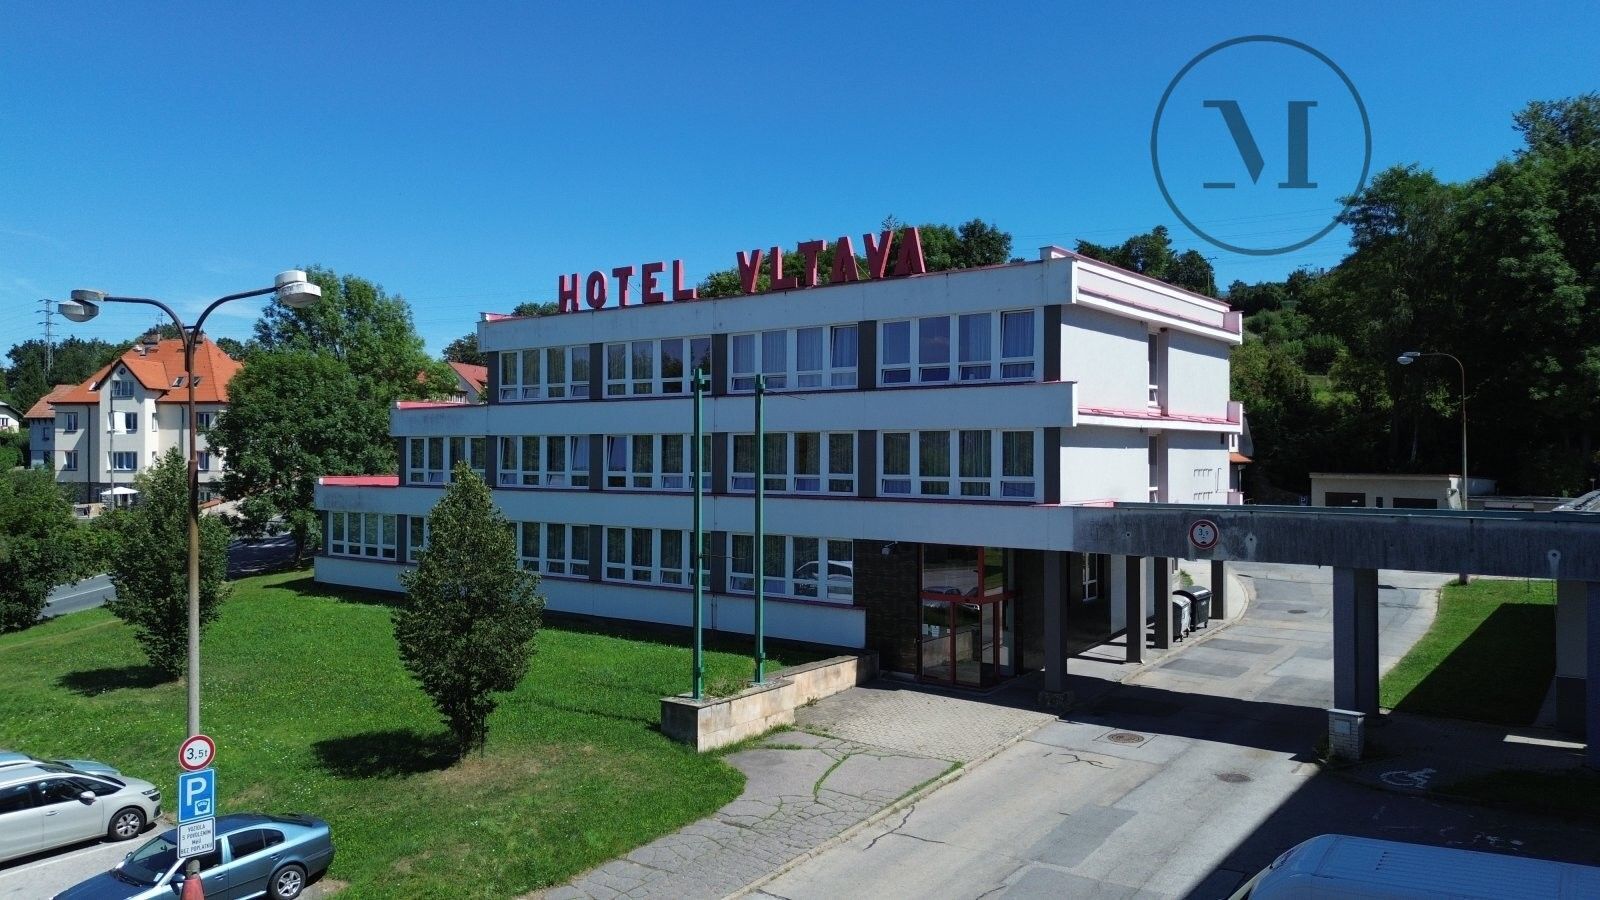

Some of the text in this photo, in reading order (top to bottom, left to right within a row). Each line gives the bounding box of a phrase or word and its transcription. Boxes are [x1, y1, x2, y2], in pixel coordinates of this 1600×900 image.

[558, 226, 926, 313] HOTEL VLTAVA
[186, 777, 207, 807] P
